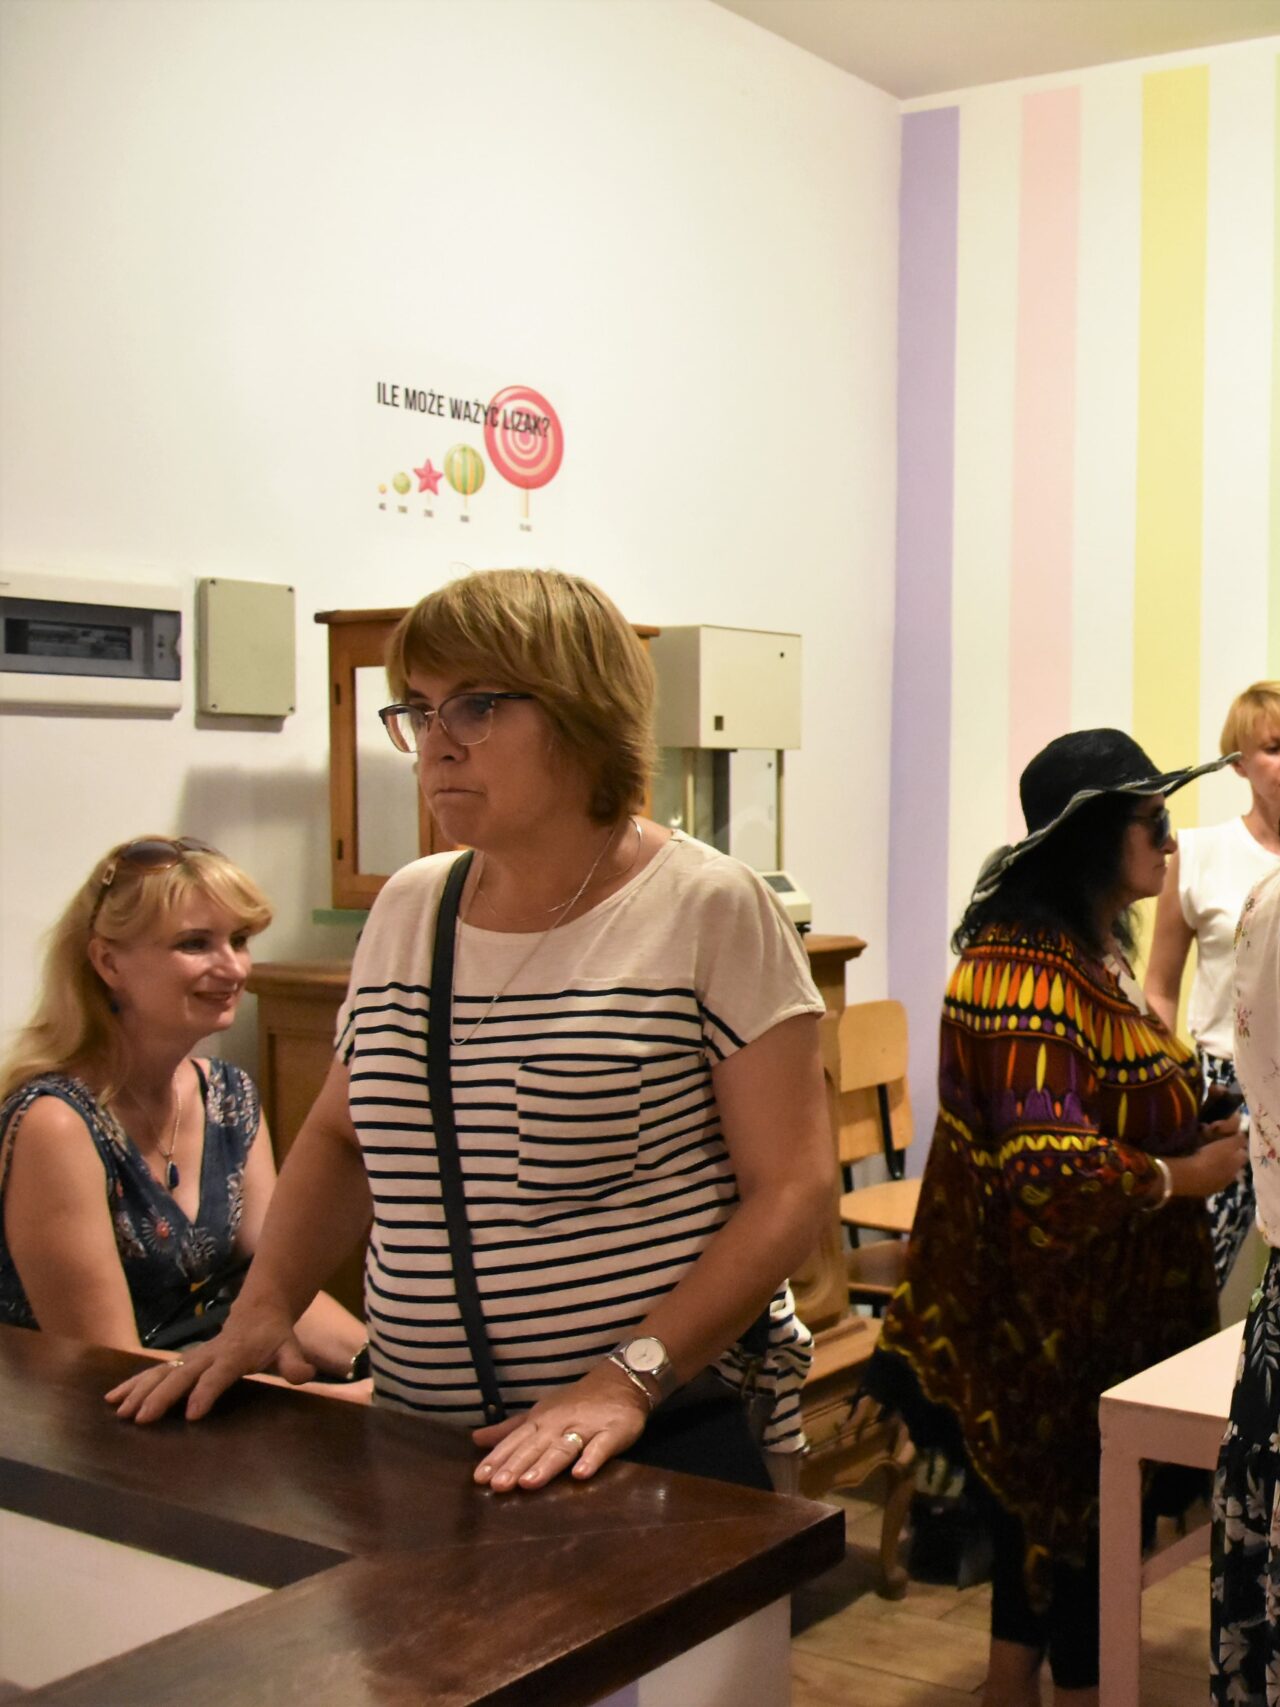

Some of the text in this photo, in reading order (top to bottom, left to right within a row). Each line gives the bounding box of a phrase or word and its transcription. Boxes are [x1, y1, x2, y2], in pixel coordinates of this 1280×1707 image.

[376, 381, 550, 438] ILE MOŻE WAŻYĆ LIZAK?
